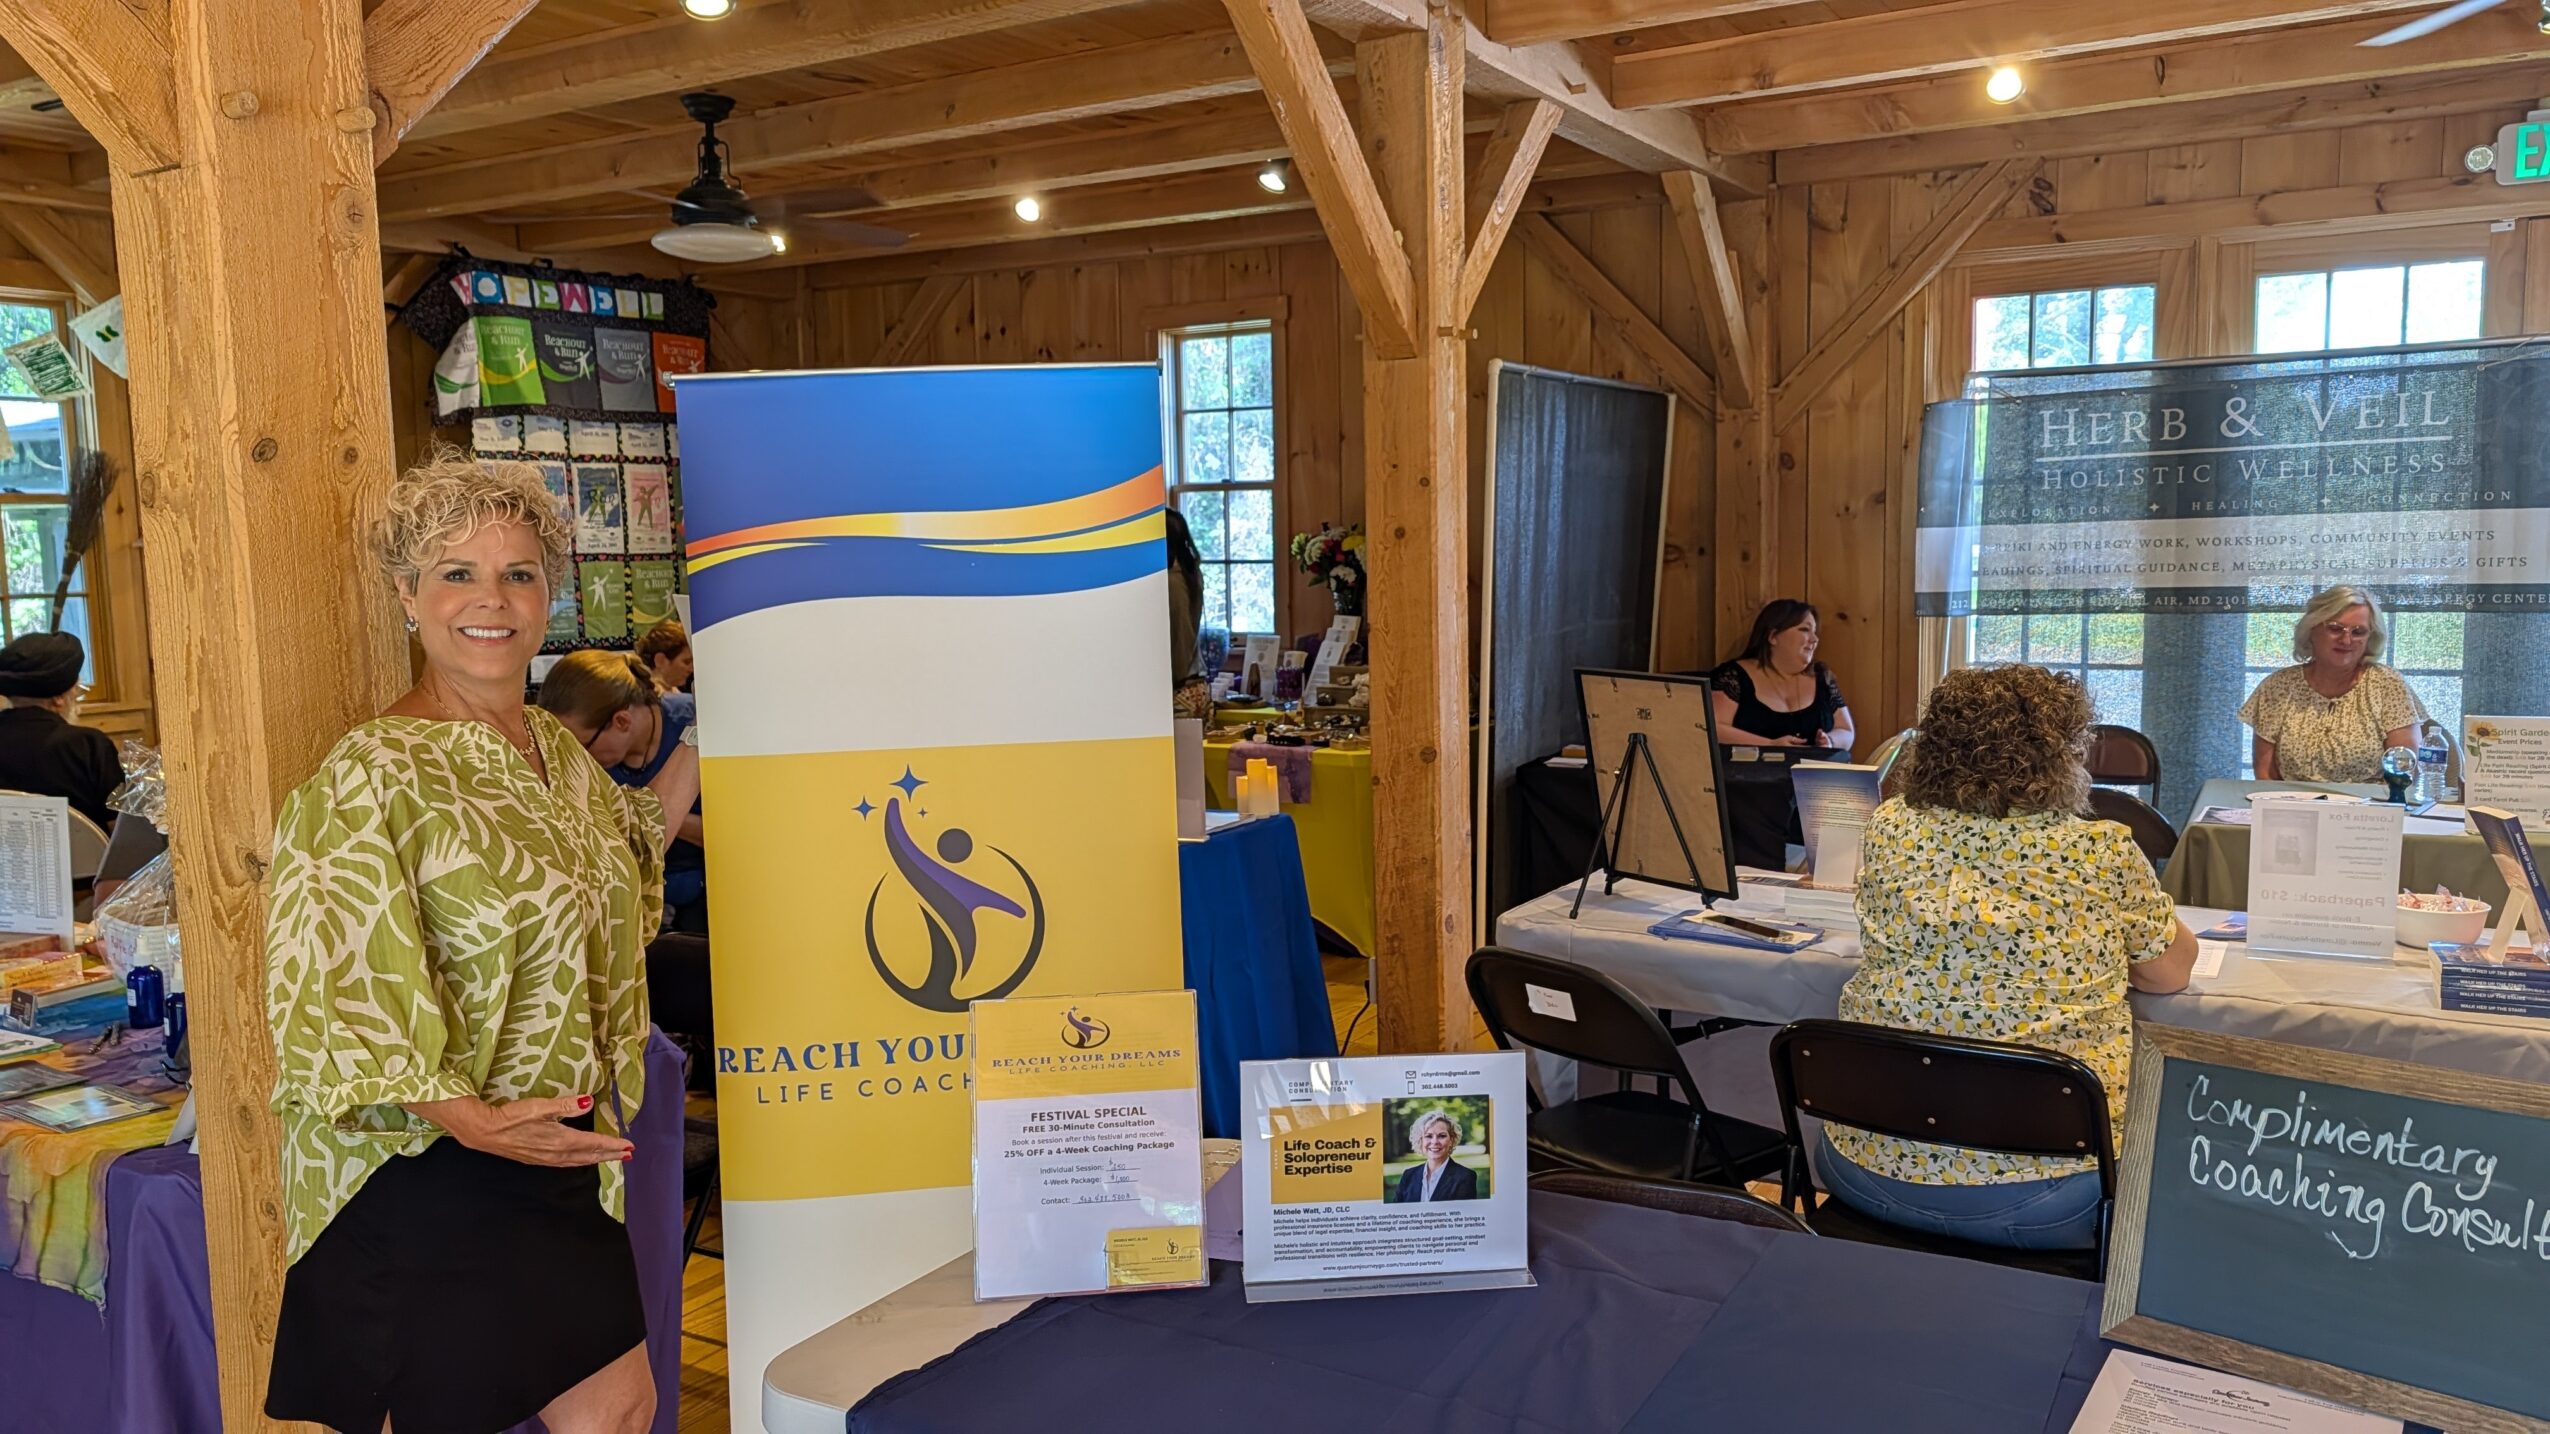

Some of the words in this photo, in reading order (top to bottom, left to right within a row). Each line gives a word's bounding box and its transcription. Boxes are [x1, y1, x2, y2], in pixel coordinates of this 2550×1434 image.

[560, 346, 578, 358] Run
[618, 350, 637, 361] Run
[2038, 407, 2188, 449] HERB
[2219, 396, 2265, 439] &
[2302, 390, 2450, 432] VEIL
[2041, 464, 2211, 490] HOLISTIC
[2237, 453, 2446, 481] WELLNESS
[1986, 504, 2112, 518] EXPLORATION
[2191, 498, 2279, 512] HEALING
[2366, 490, 2512, 506] CONNECTION
[1994, 540, 2032, 553] REIKI
[2038, 540, 2069, 552] AND
[2072, 538, 2134, 551] ENERGY
[2137, 537, 2190, 550] WORK,
[2196, 534, 2304, 548] WORKSHOPS,
[2310, 530, 2420, 544] COMMUNITY
[2428, 530, 2496, 542] EVENTS
[2055, 562, 2133, 576] SPIRITUAL
[2137, 561, 2226, 574] GUIDANCE,
[2232, 558, 2360, 573] METAPHYSICAL
[2367, 556, 2449, 570] SUPPLIES
[2454, 556, 2467, 568] &
[2476, 556, 2529, 568] GIFTS
[2154, 596, 2183, 606] AIR,
[2188, 596, 2211, 606] MD
[2216, 596, 2253, 606] 2101
[2424, 592, 2486, 604] ENERGY
[2490, 727, 2518, 738] Spirit
[2498, 738, 2518, 746] Event
[2520, 738, 2543, 746] Prices
[717, 1040, 860, 1074] REACH
[876, 1033, 977, 1065] YOU
[992, 1056, 1051, 1068] REACH
[1058, 1053, 1105, 1064] YOUR
[1110, 1049, 1182, 1062] DREAMS
[1008, 1066, 1041, 1075] LIFE
[1139, 1060, 1166, 1068] LLC
[1288, 1080, 1354, 1088] COMPTARY
[1288, 1086, 1348, 1094] CONSUTION
[757, 1082, 834, 1104] LIFE
[1030, 1110, 1091, 1122] FESTIVAL
[1094, 1106, 1148, 1119] SPECIAL
[1022, 1124, 1046, 1134] FREE
[1048, 1122, 1096, 1132] 30-Minute
[1097, 1118, 1156, 1130] Consultation
[1012, 1138, 1030, 1146] Book
[1037, 1136, 1064, 1144] session
[1065, 1135, 1081, 1144] after
[1083, 1134, 1096, 1142] this
[1097, 1132, 1123, 1141] festival
[1124, 1132, 1138, 1140] and
[1139, 1130, 1167, 1139] receive:
[1284, 1139, 1311, 1151] Life
[1314, 1138, 1360, 1150] Coach
[1364, 1138, 1376, 1148] &
[2186, 1074, 2498, 1201] Complimentary
[1004, 1150, 1024, 1158] 25%
[1026, 1148, 1045, 1157] OFF
[1055, 1146, 1090, 1155] 4-Week
[1092, 1142, 1134, 1154] Coaching
[1136, 1140, 1175, 1150] Package
[1284, 1151, 1372, 1165] Solopreneur
[1040, 1166, 1074, 1174] Individual
[1075, 1164, 1104, 1172] Session:
[1284, 1162, 1353, 1177] Expertise
[1043, 1178, 1069, 1186] 4-Week
[1070, 1176, 1102, 1184] Package:
[1041, 1197, 1070, 1205] Contact:
[2189, 1134, 2387, 1259] Coaching
[2401, 1181, 2550, 1261] Consult
[1273, 1208, 1302, 1216] Michele
[1302, 1207, 1321, 1215] Watt,
[1322, 1206, 1335, 1214] JD,
